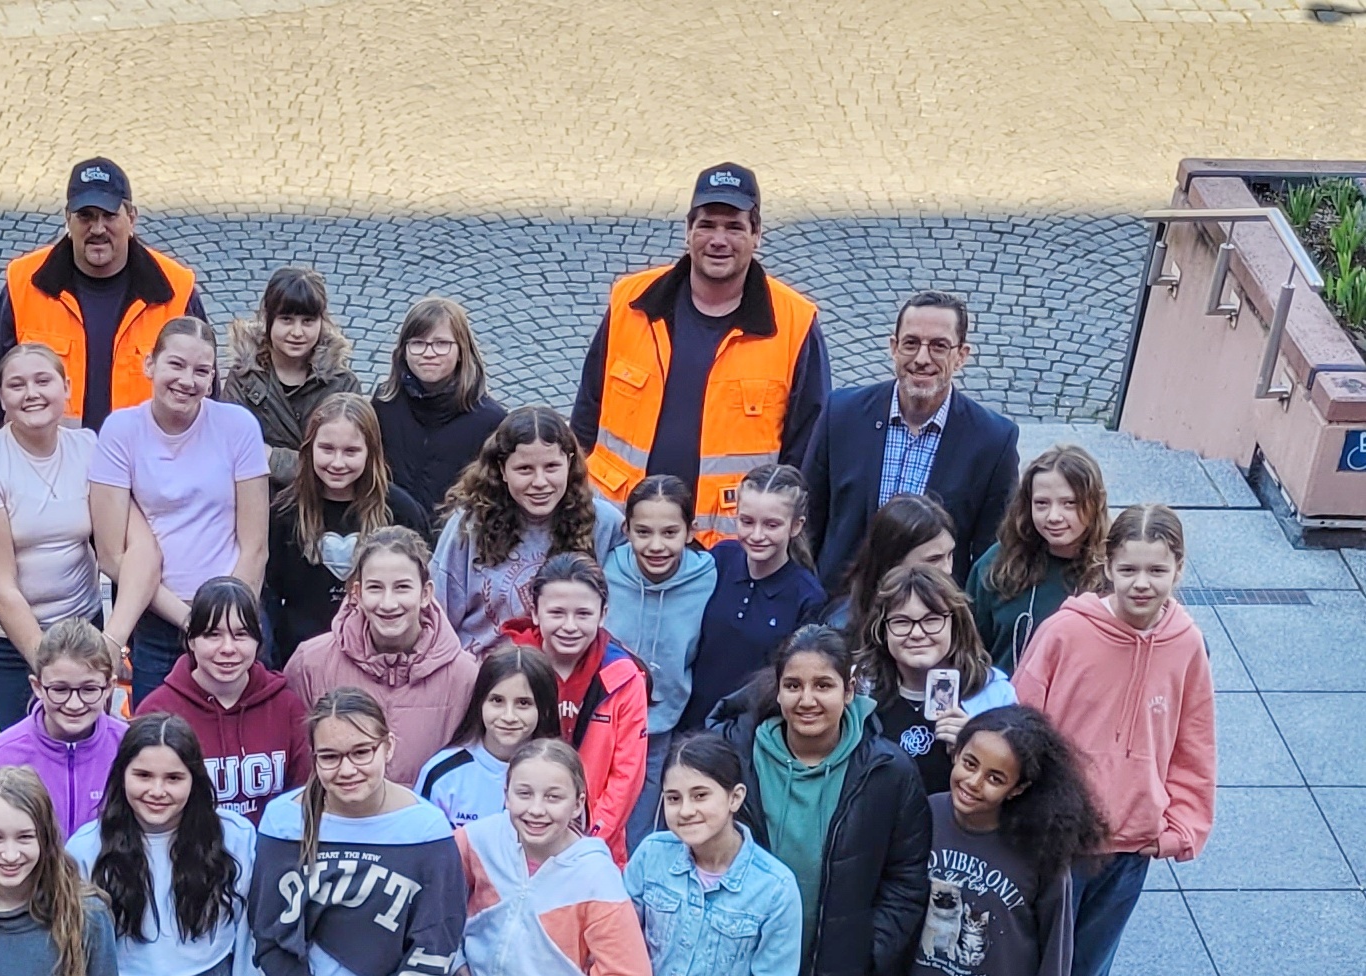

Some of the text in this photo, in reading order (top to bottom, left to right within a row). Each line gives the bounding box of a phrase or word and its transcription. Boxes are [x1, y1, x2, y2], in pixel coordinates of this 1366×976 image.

[456, 811, 478, 821] JAKO
[344, 851, 360, 859] THE
[361, 852, 382, 863] NEW
[941, 849, 988, 877] VIBES
[985, 869, 1025, 911] ONLY
